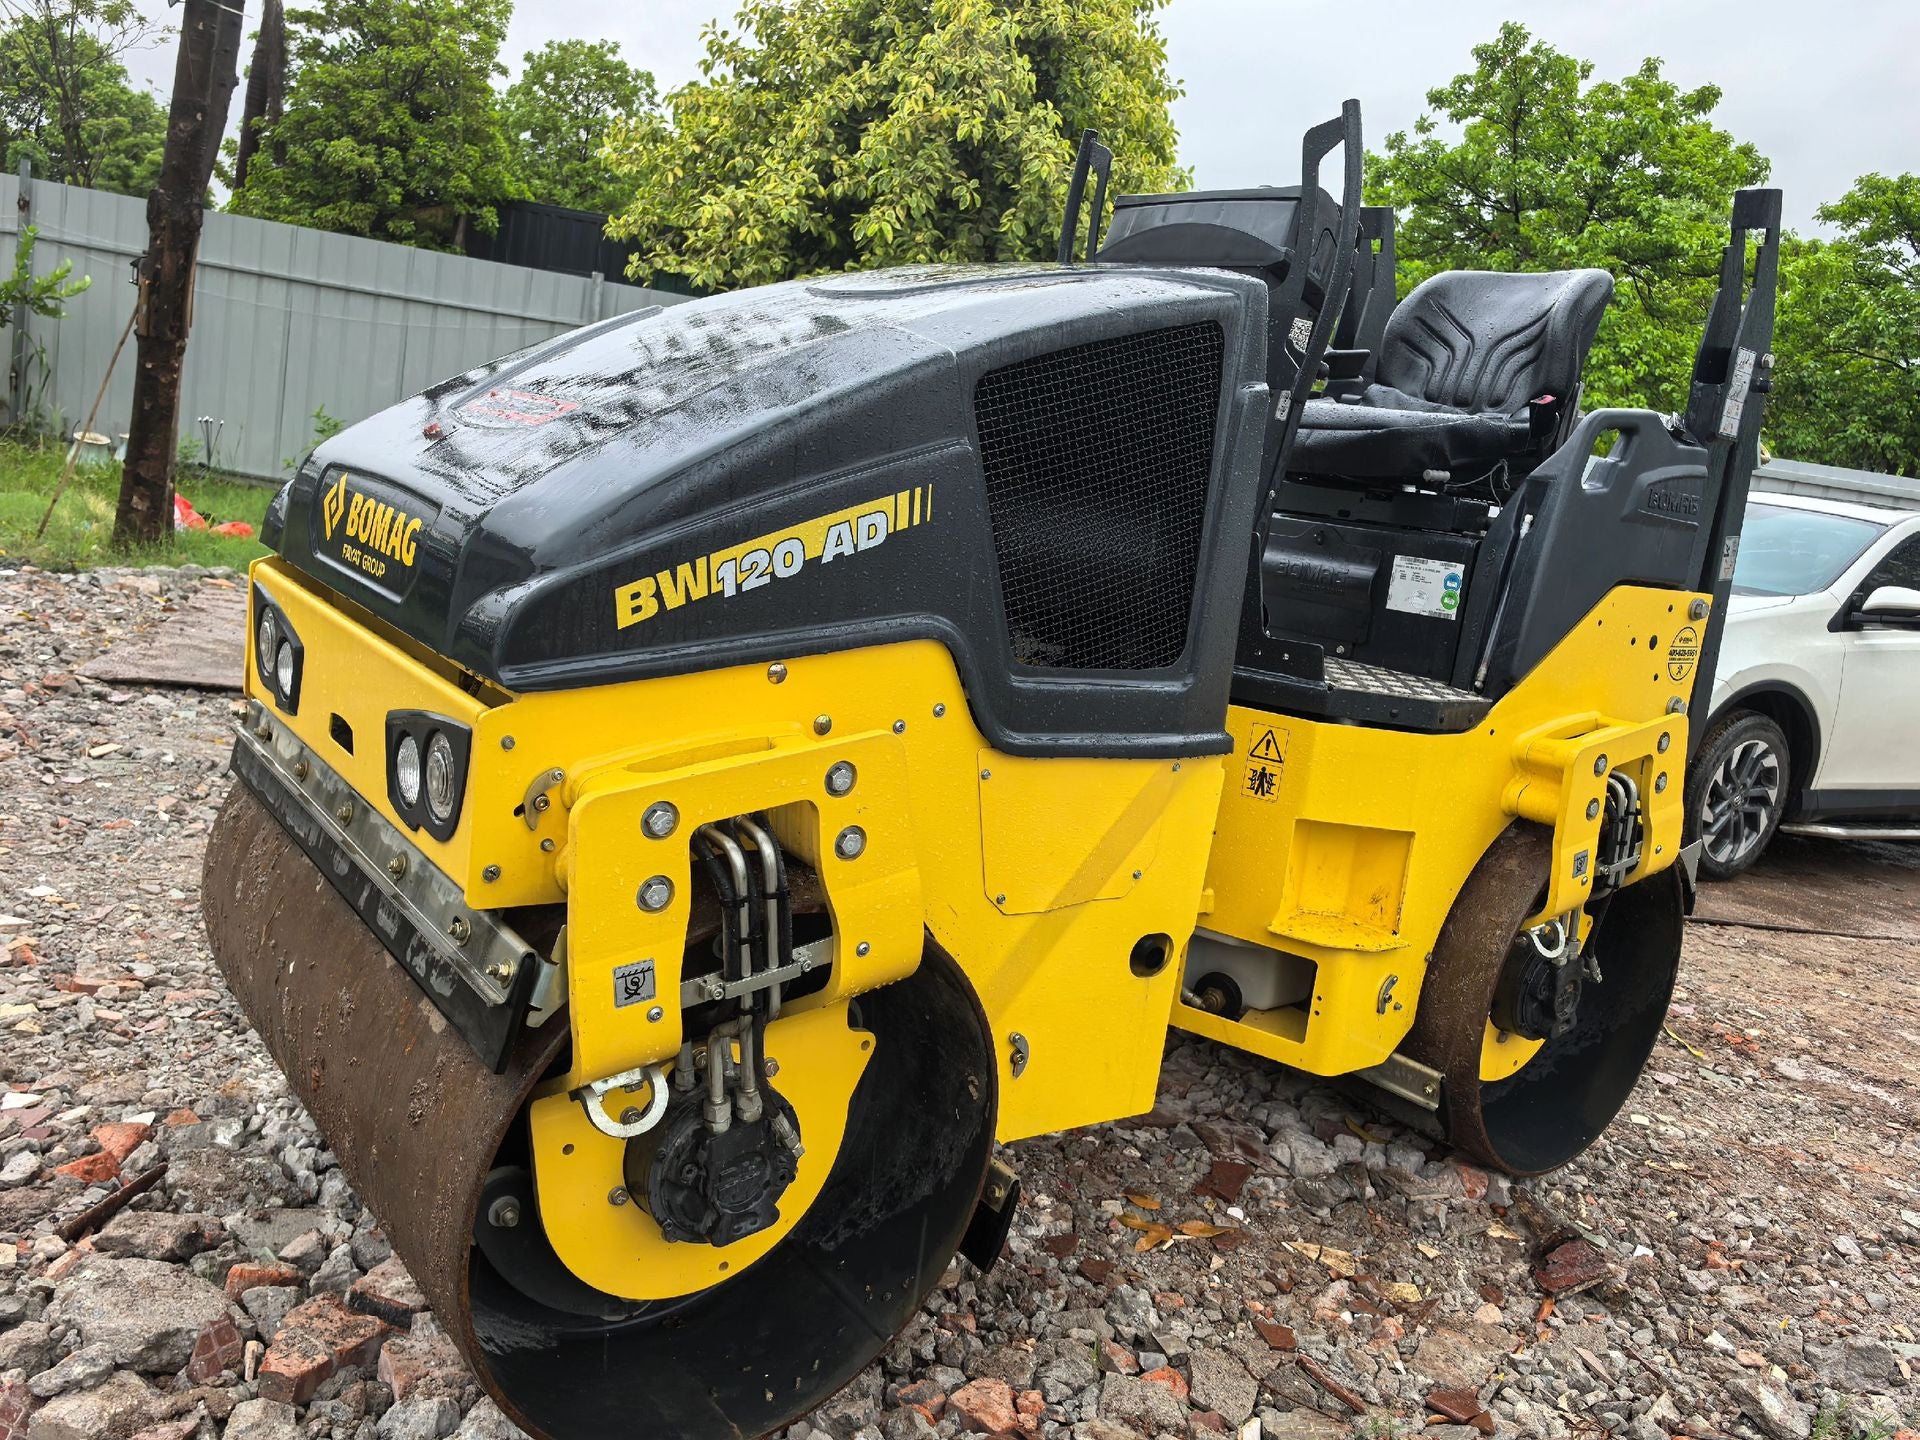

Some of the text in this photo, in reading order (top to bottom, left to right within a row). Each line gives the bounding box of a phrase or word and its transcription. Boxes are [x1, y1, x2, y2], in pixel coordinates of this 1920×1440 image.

[341, 543, 386, 578] FAYAT GROUP
[346, 492, 423, 567] BOMAG
[615, 510, 889, 630] BW 120 AD
